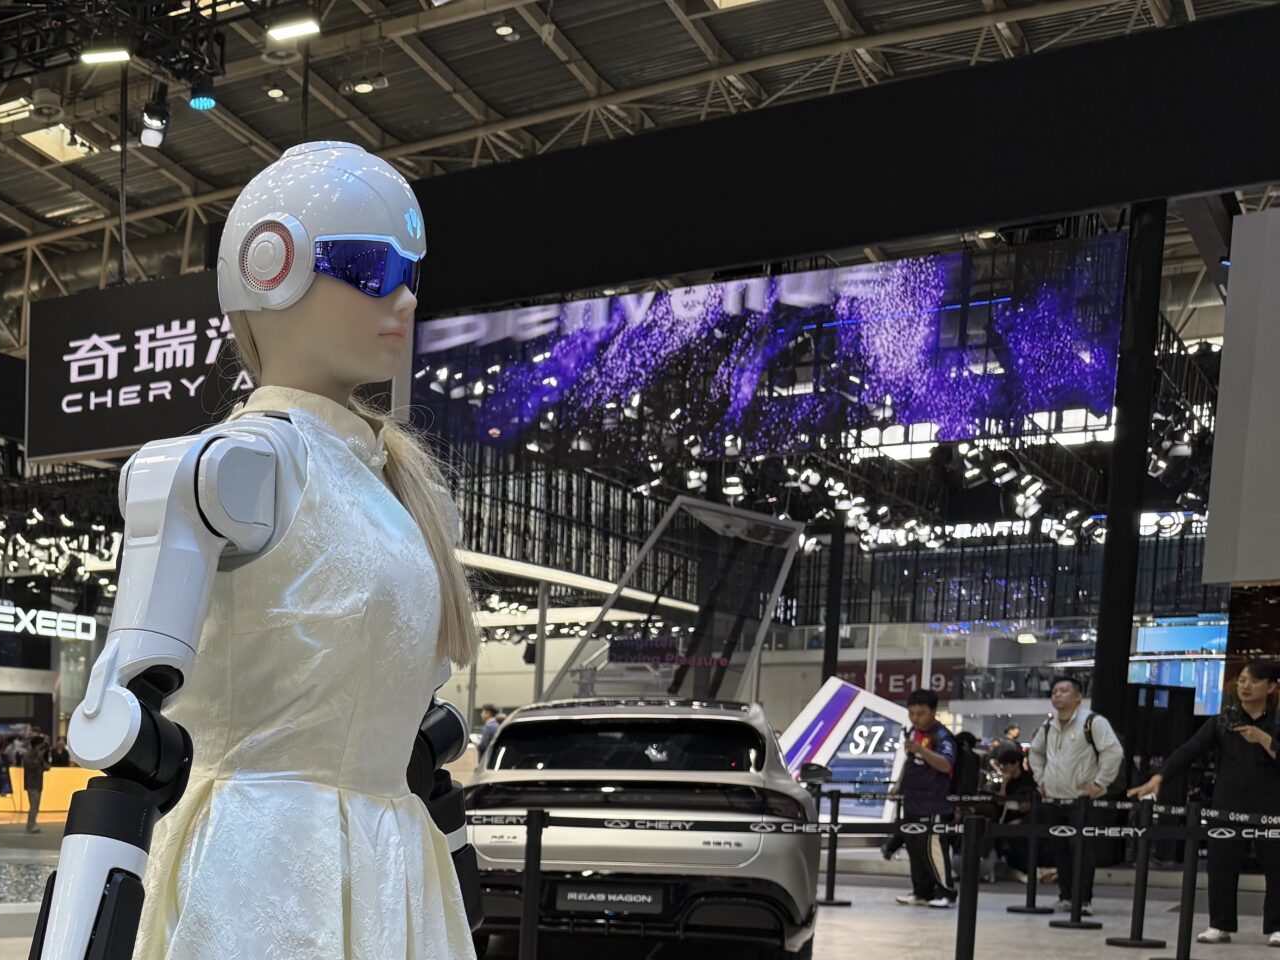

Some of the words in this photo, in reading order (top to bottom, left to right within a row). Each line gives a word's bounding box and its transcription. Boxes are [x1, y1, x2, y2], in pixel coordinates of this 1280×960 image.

[61, 375, 206, 413] CHERY
[232, 370, 255, 391] A
[849, 725, 885, 755] S7
[472, 816, 527, 825] CHERY
[634, 820, 694, 830] CHERY
[781, 823, 842, 833] CHERY
[1082, 827, 1147, 837] CHERY
[1241, 828, 1280, 839] CHE
